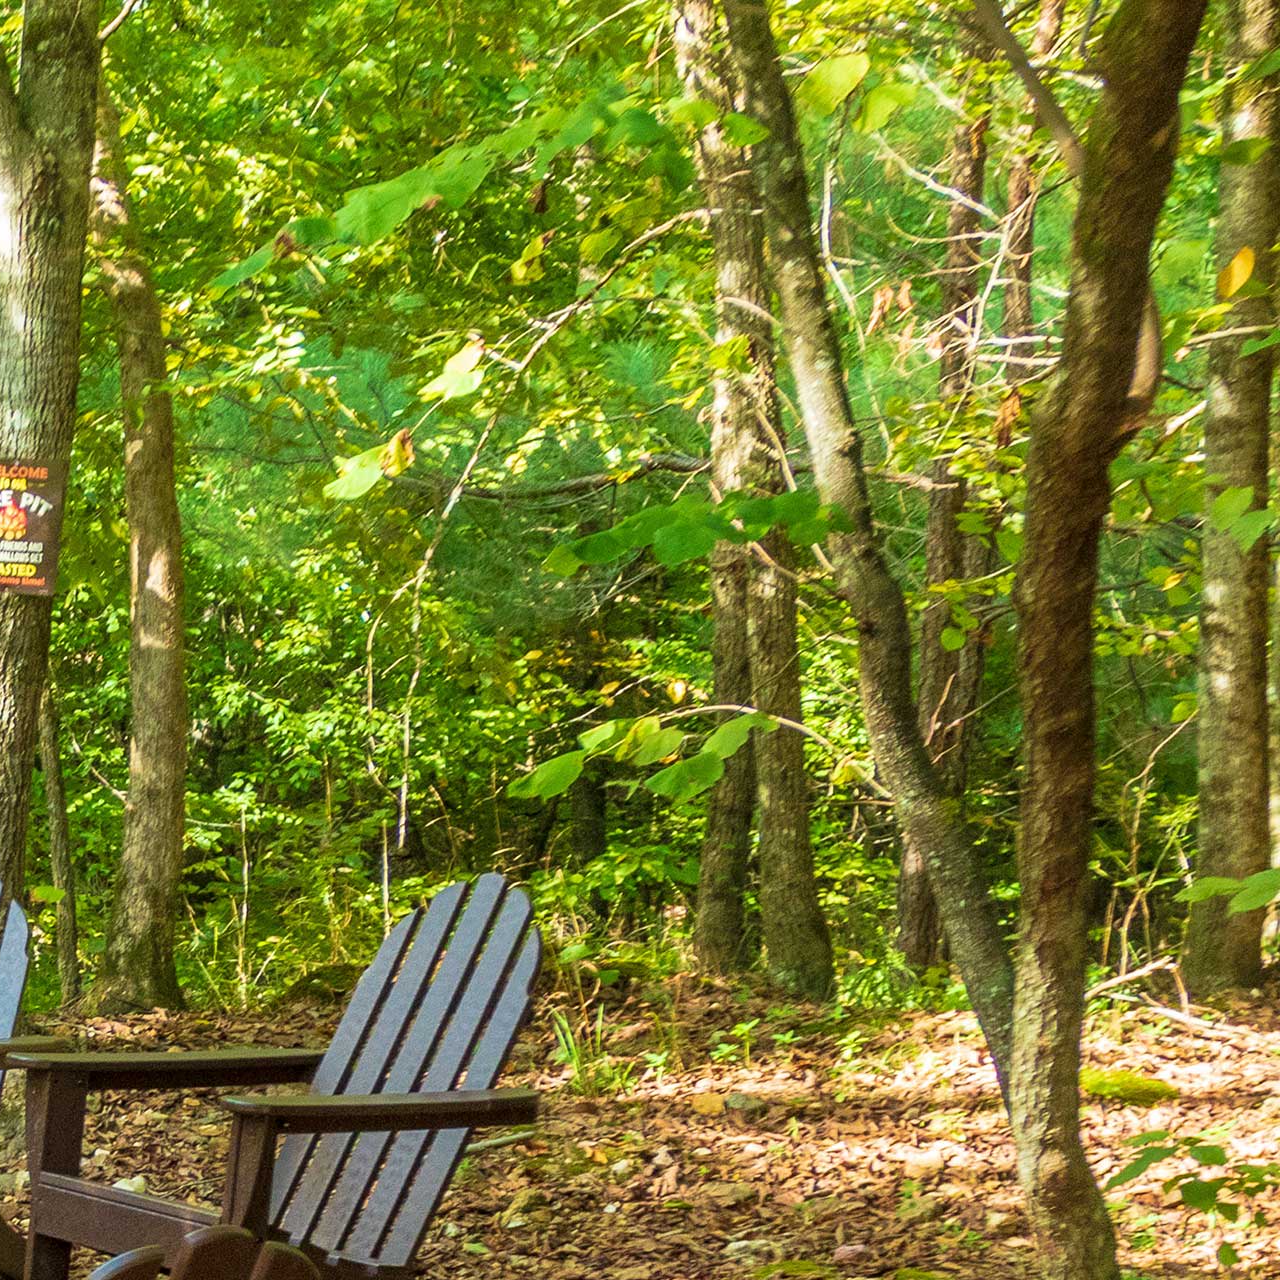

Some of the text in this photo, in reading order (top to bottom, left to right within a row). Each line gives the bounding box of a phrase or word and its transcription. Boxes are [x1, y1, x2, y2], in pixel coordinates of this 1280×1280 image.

[19, 492, 53, 517] PIT
[0, 540, 28, 551] FRIENDS
[28, 541, 43, 552] AND
[30, 552, 43, 563] GET
